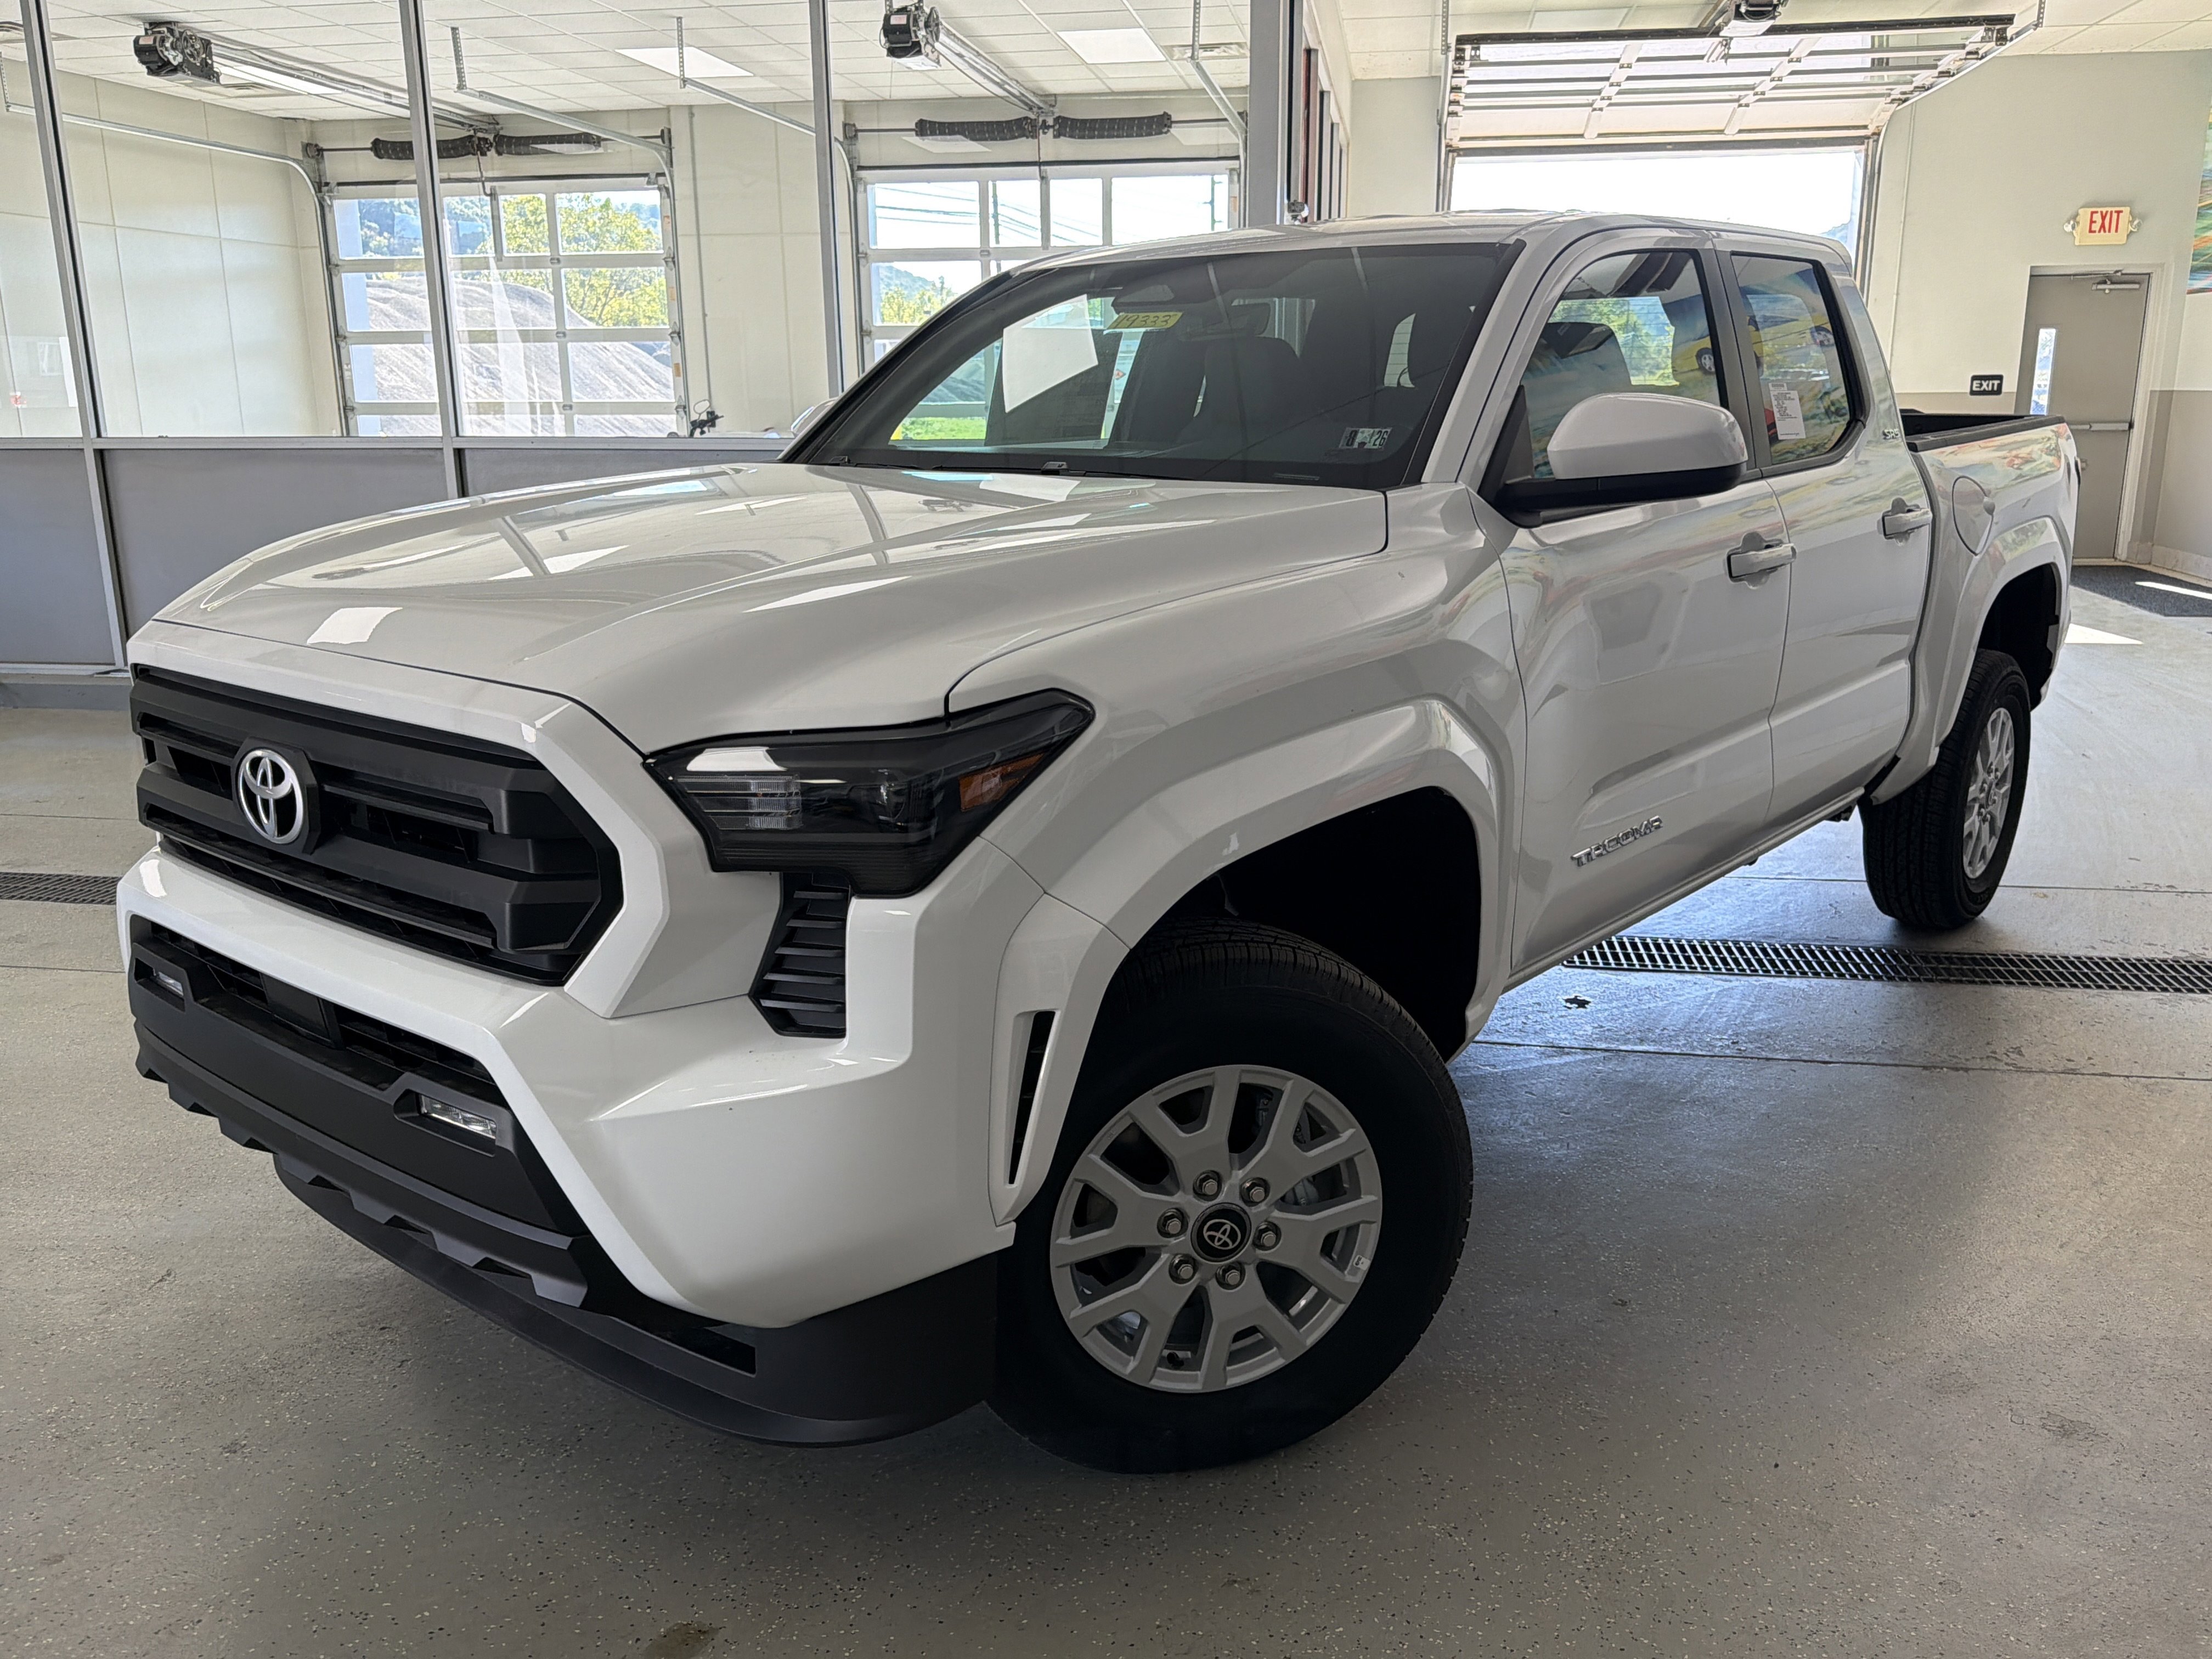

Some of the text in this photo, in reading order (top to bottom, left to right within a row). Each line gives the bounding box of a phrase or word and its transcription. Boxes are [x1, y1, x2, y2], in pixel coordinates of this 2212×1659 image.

[2088, 210, 2123, 234] EXIT
[1972, 380, 2000, 391] EXIT
[1372, 430, 1389, 447] 26
[1883, 428, 1901, 439] SR5
[1570, 815, 1663, 867] TACOMA
